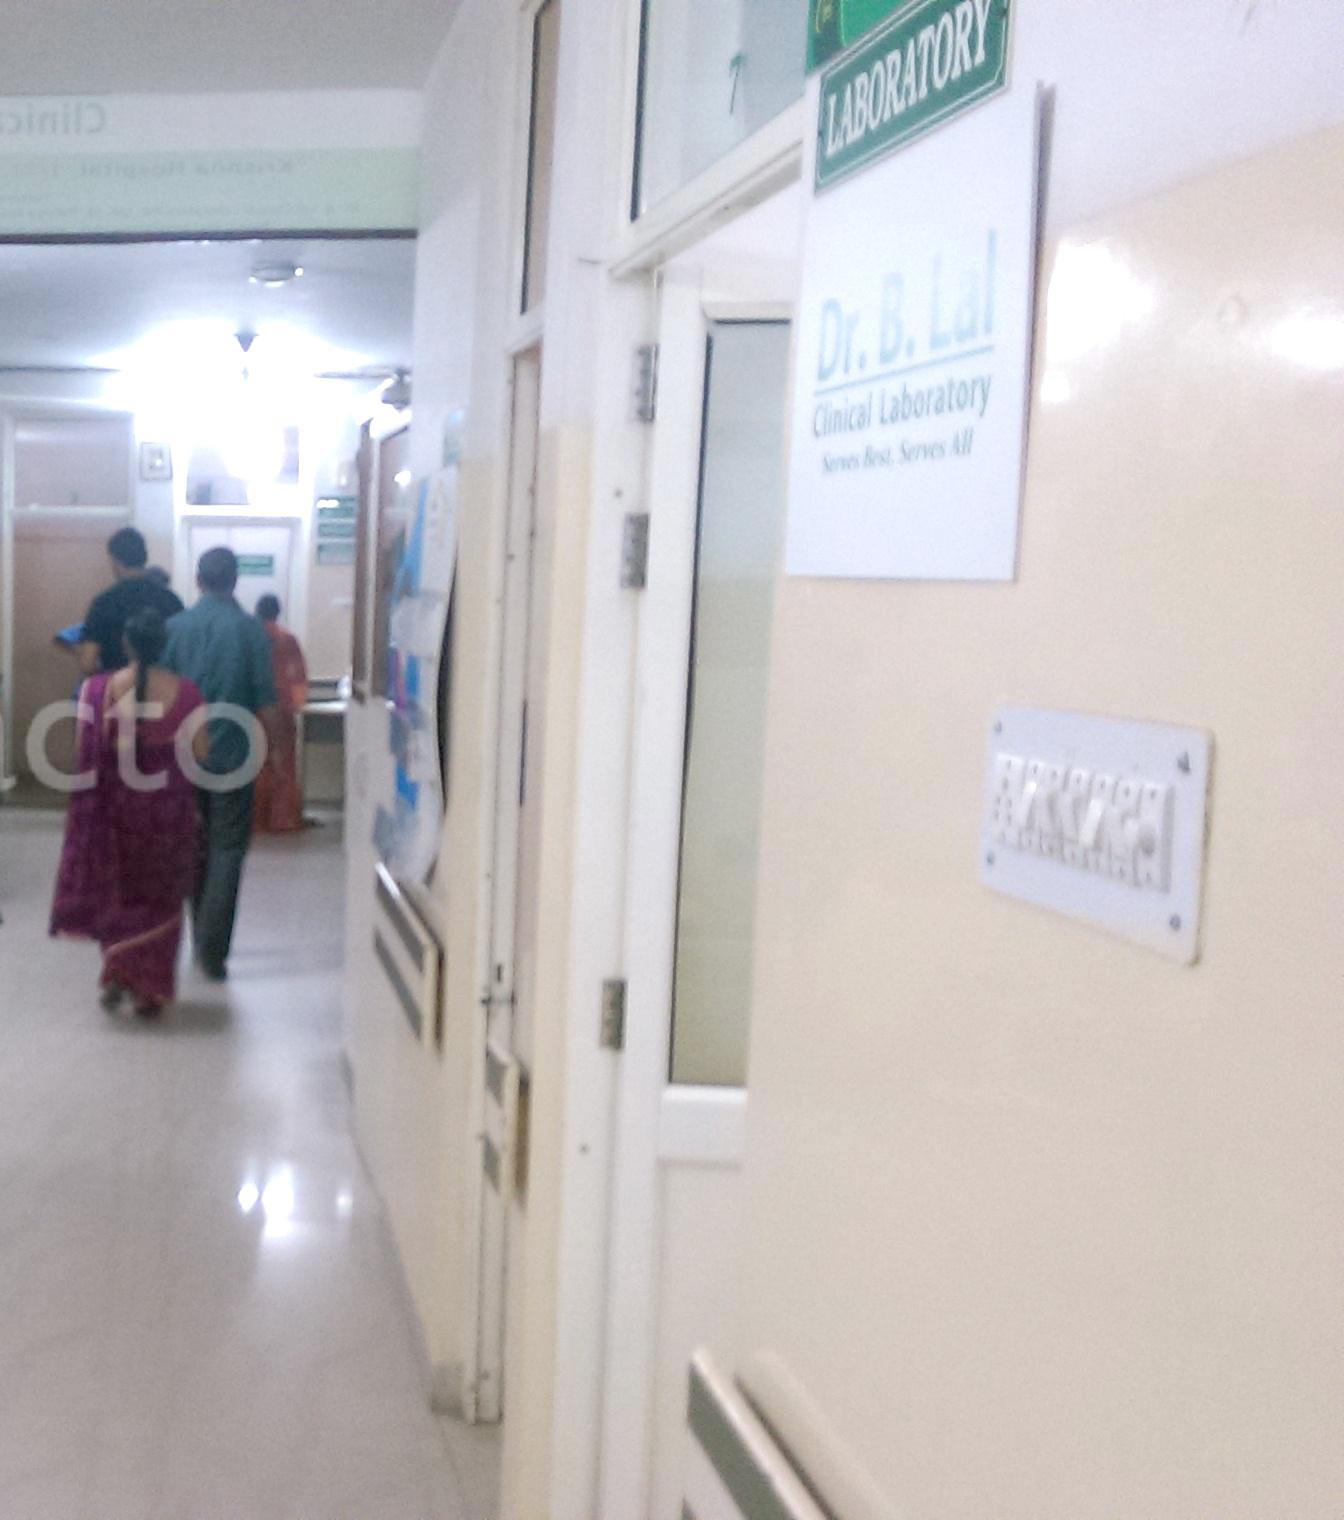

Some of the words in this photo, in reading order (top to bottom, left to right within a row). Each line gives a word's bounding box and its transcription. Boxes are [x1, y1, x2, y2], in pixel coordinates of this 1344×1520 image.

[825, 0, 992, 158] LABORATORY
[817, 297, 867, 382] Dr.
[879, 272, 915, 365] B.
[929, 227, 997, 350] Lal
[813, 391, 873, 438] Clinical
[879, 374, 992, 419] Laboratory
[822, 451, 859, 473] Serves
[900, 439, 946, 465] Serves
[952, 426, 975, 456] All
